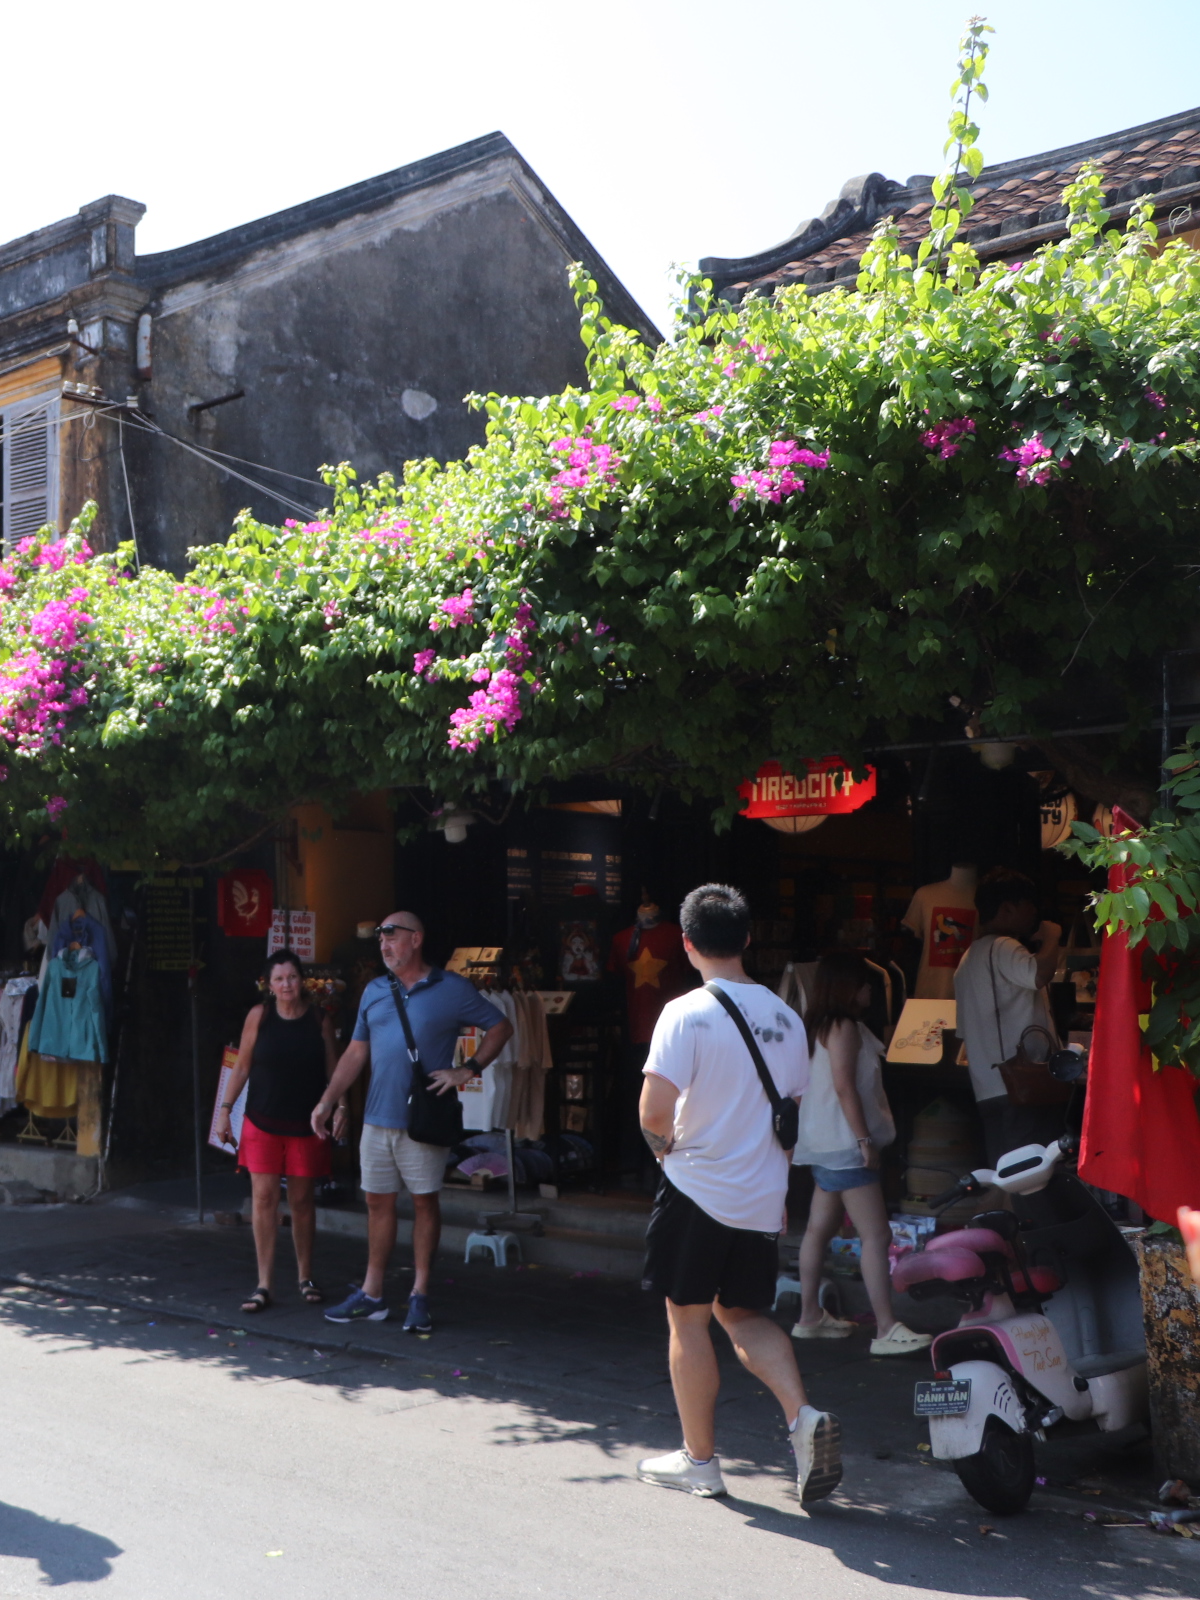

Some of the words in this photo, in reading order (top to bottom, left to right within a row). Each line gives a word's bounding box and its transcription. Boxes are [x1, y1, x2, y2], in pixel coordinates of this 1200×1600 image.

[273, 914, 290, 923] POS
[293, 915, 311, 924] CARD
[297, 937, 311, 946] 5G
[917, 1391, 945, 1403] CẢNH
